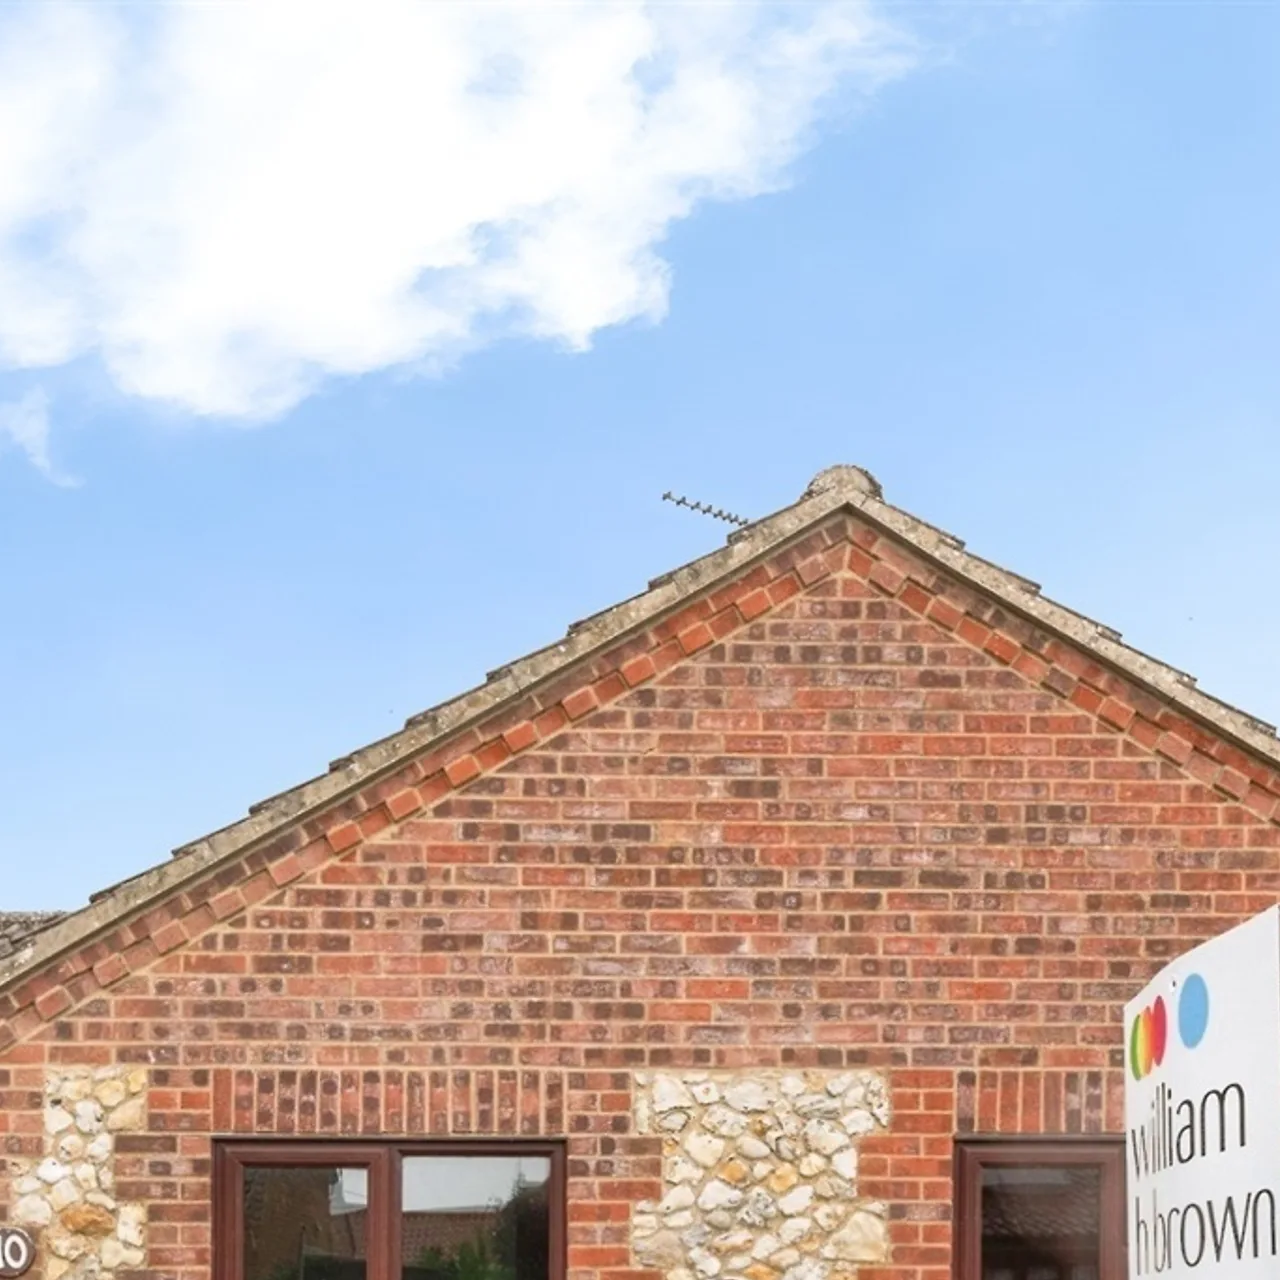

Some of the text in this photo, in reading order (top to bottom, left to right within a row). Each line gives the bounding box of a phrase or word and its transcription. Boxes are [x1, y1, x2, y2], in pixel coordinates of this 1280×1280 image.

[1131, 1082, 1246, 1181] william
[1135, 1188, 1277, 1277] h brown
